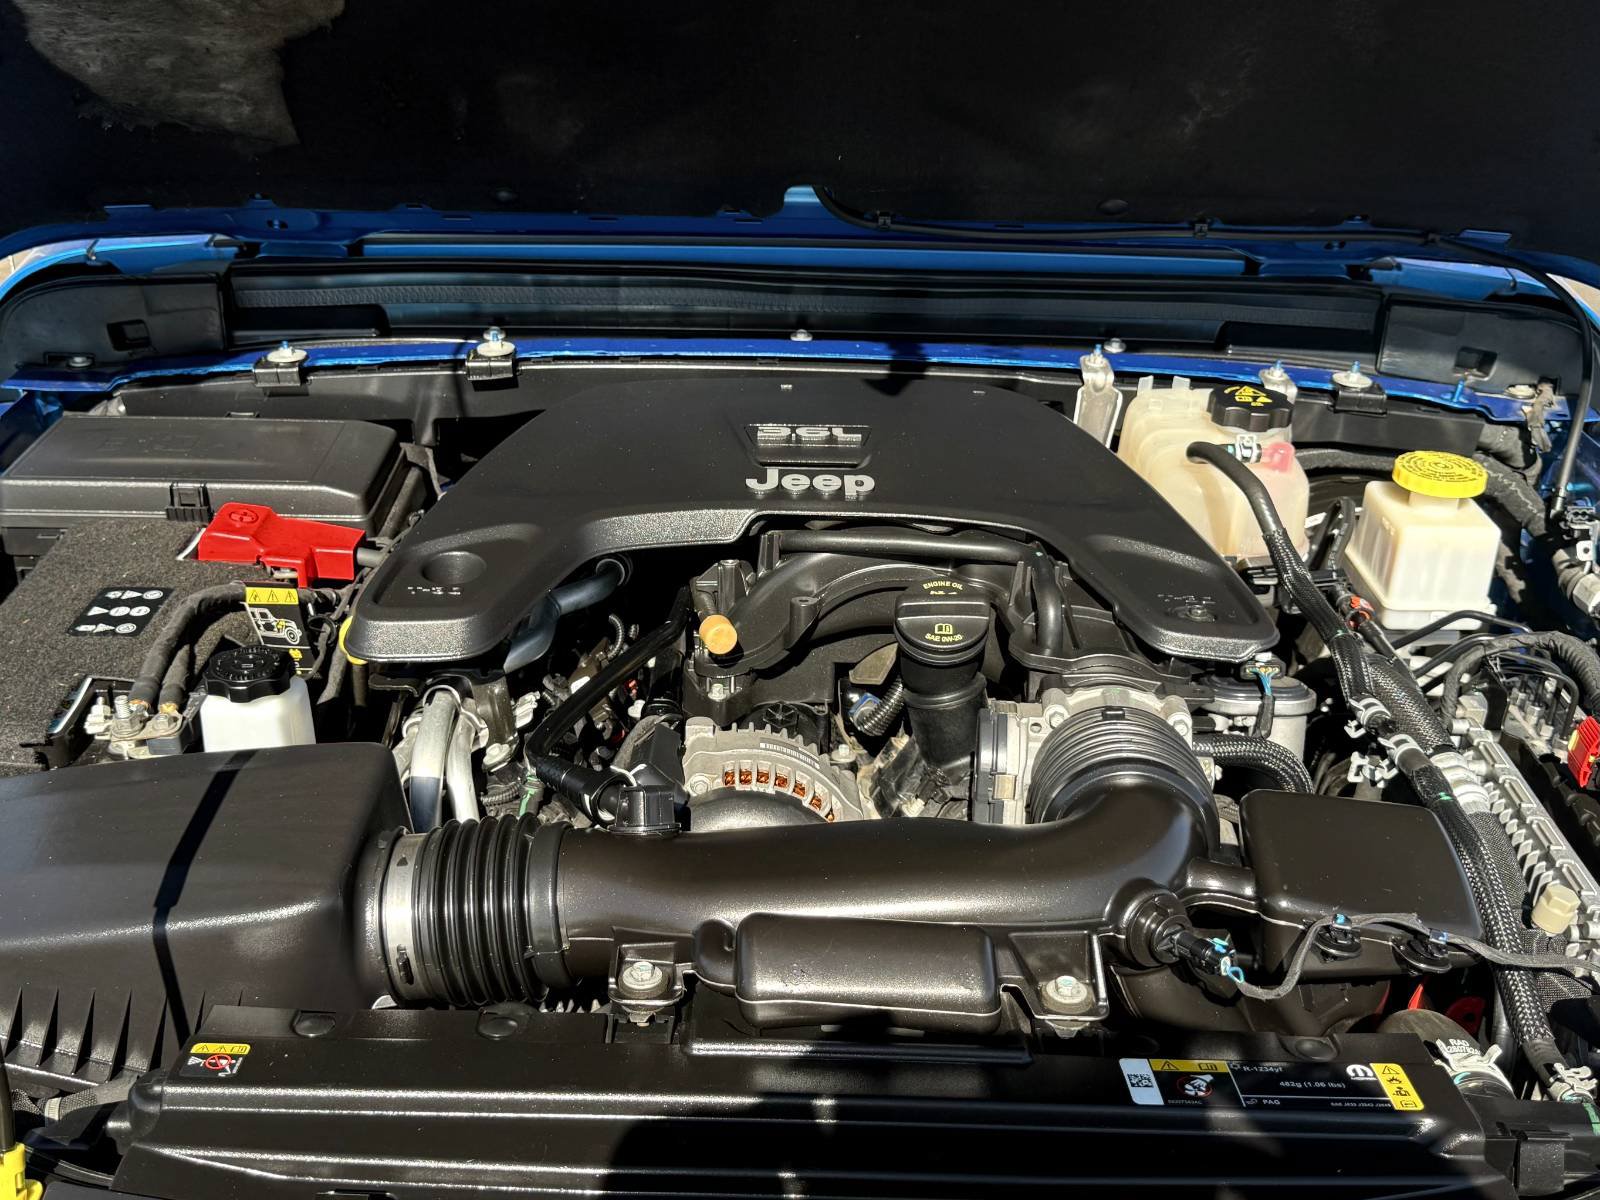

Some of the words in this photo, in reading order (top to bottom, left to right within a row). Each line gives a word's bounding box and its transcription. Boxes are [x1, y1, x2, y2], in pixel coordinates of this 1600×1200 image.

[757, 426, 862, 441] 3.6L
[745, 468, 876, 497] Jeep
[922, 581, 951, 590] ENGINE
[951, 582, 963, 590] OIL
[925, 633, 940, 642] SAE
